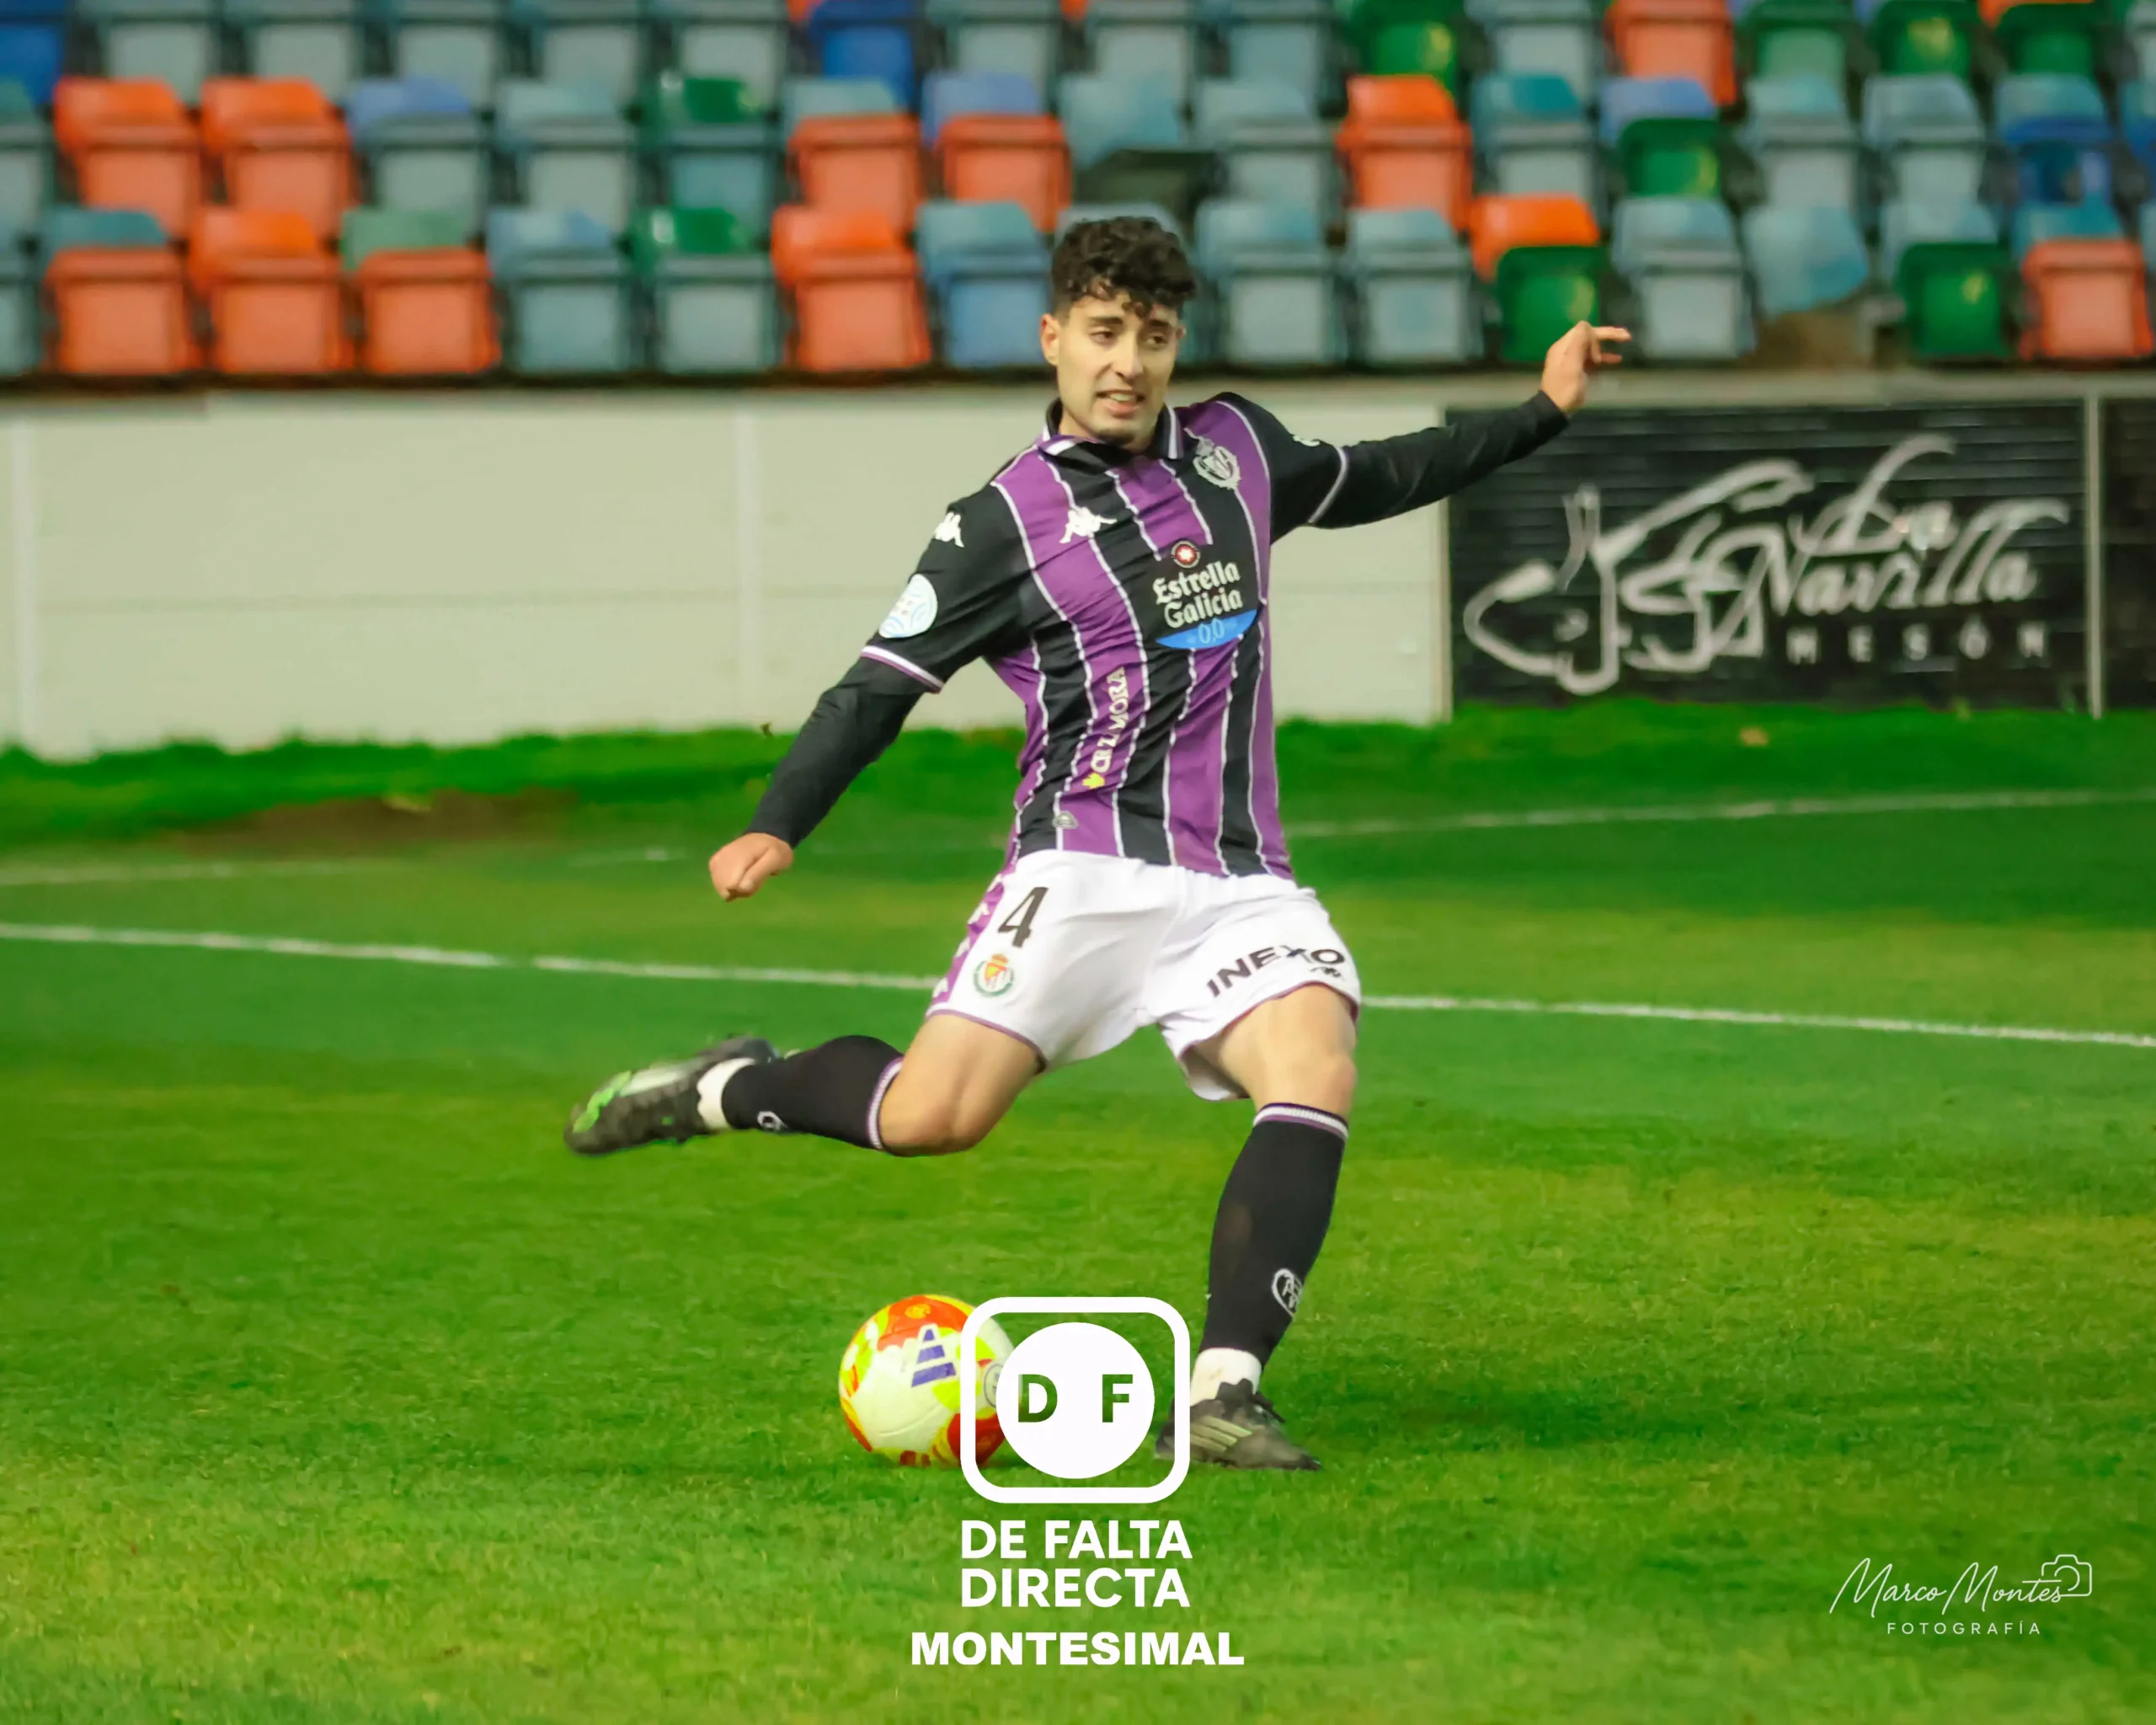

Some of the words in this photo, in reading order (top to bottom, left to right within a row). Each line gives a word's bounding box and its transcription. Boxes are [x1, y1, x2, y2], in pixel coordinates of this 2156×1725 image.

[1152, 561, 1241, 605] Estrella
[1164, 587, 1243, 628] Galicia
[997, 887, 1049, 948] 4
